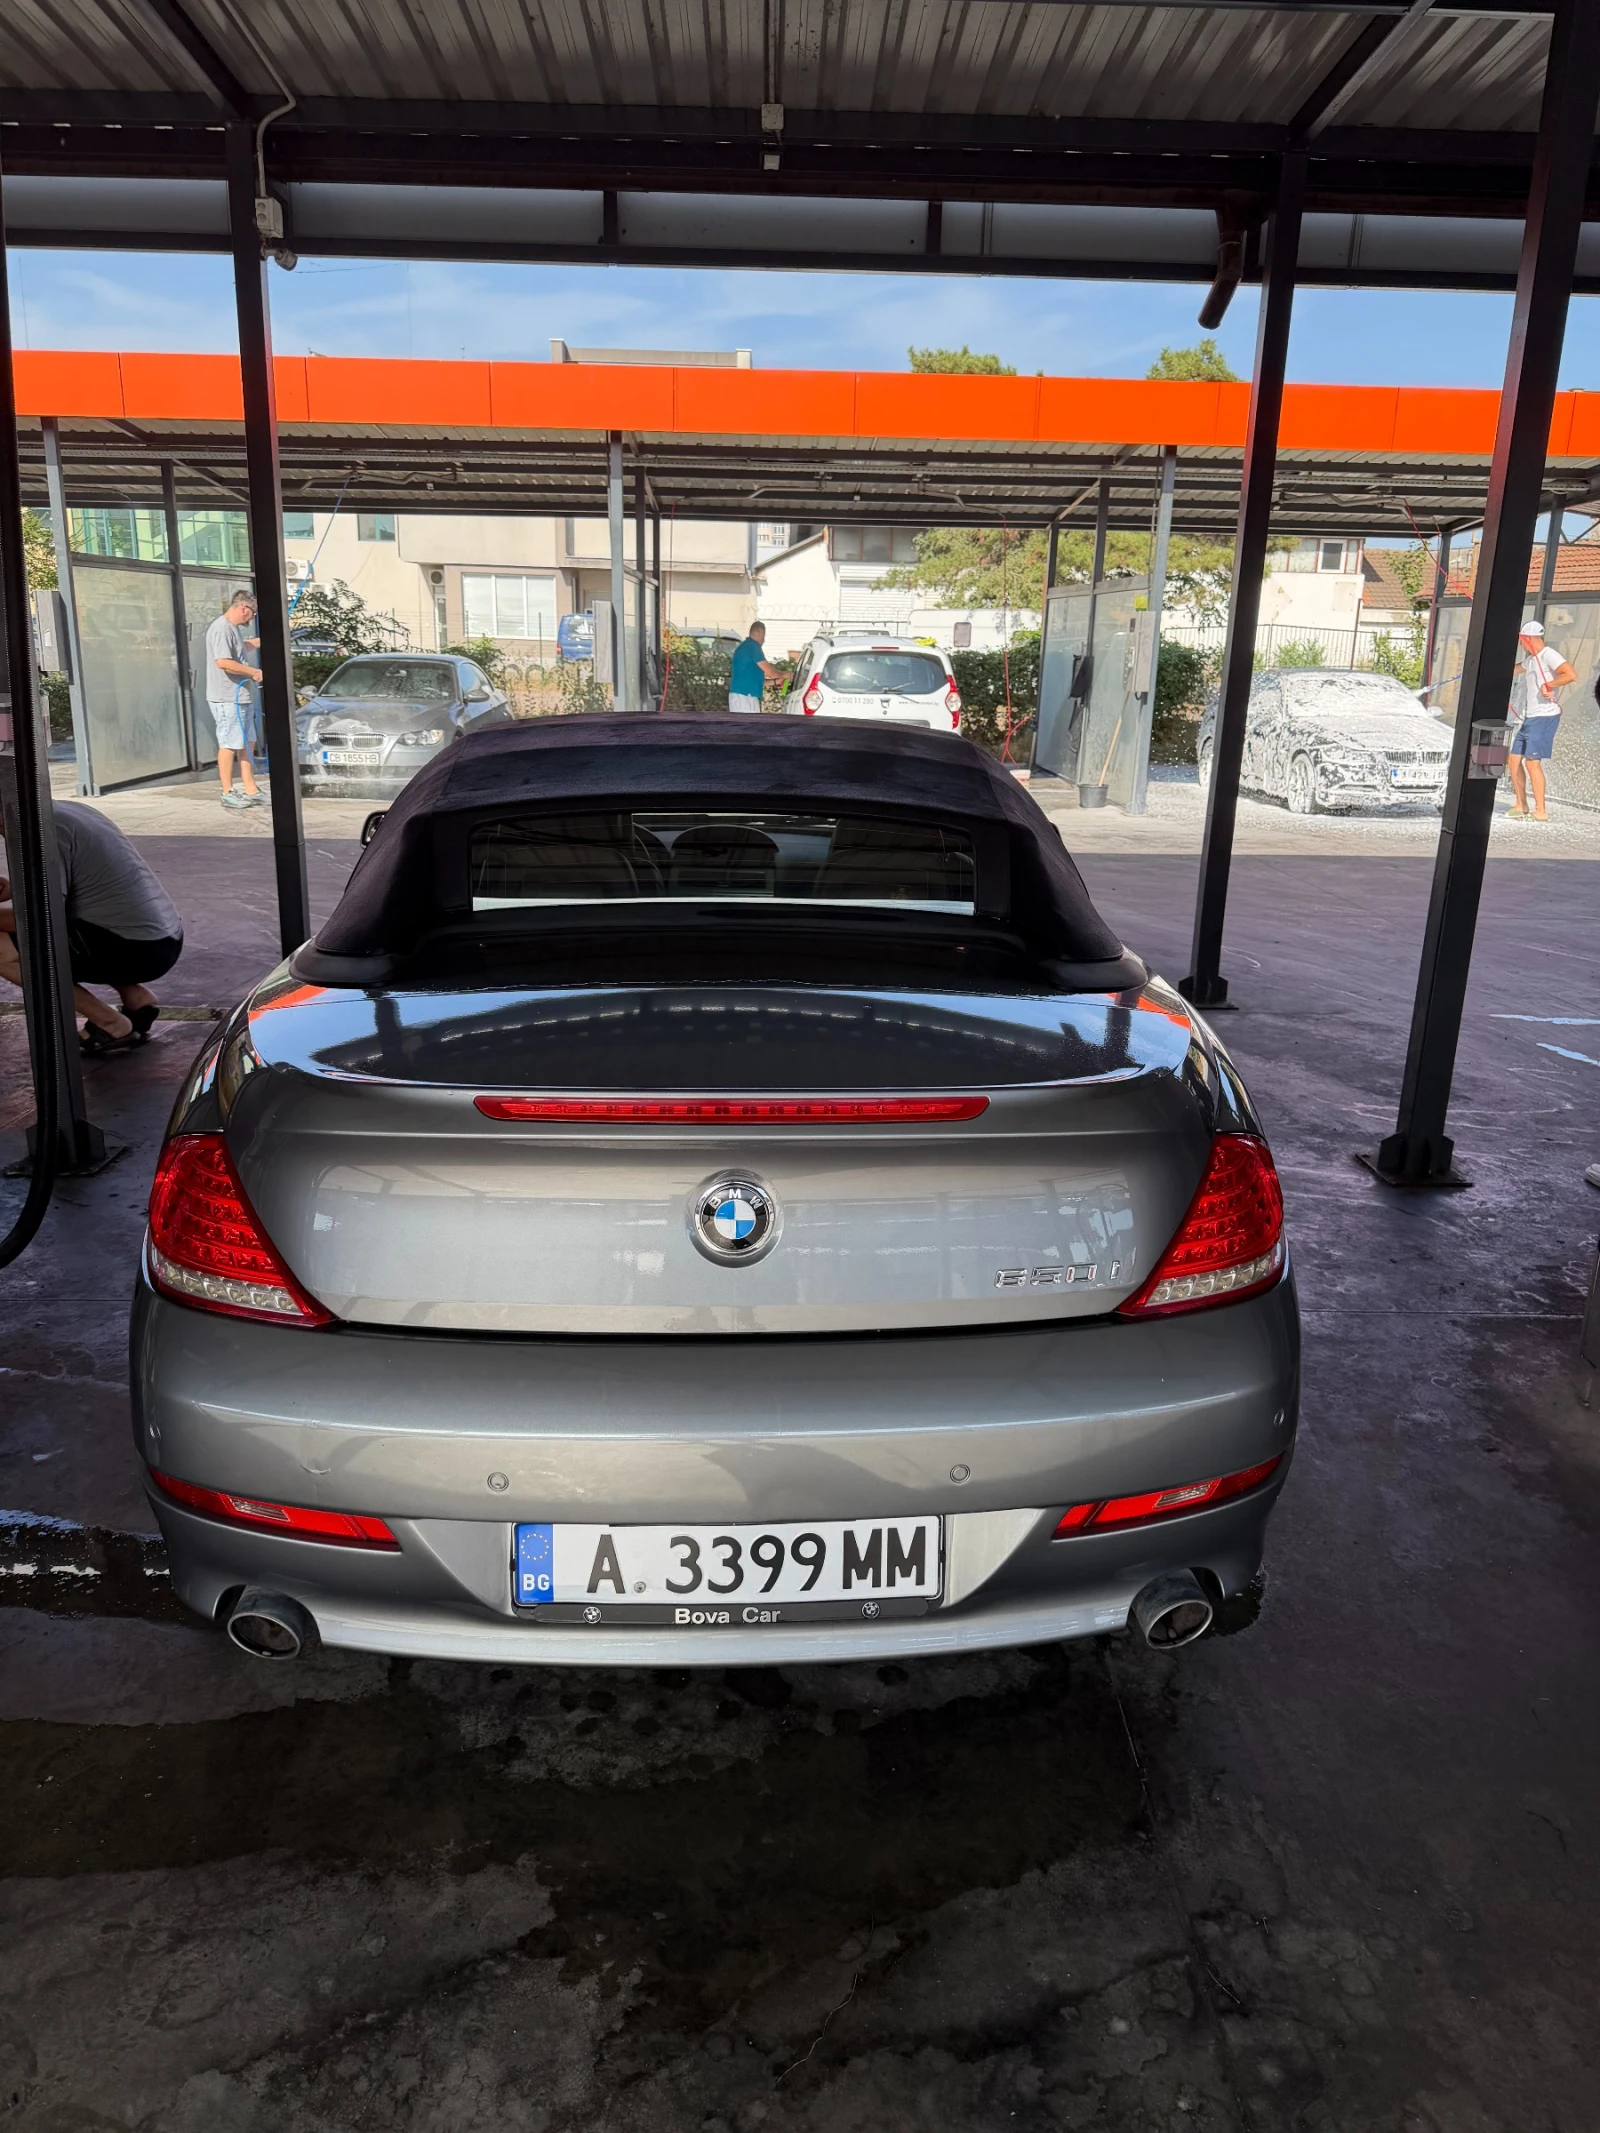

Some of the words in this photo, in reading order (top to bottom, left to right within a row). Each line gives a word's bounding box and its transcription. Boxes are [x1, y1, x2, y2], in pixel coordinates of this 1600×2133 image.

[708, 1188, 764, 1209] BMW
[522, 1574, 550, 1592] BG
[586, 1534, 626, 1594] A
[665, 1532, 827, 1594] 3399
[842, 1525, 927, 1590] MM
[674, 1608, 730, 1625] Bova
[742, 1607, 781, 1624] Car
